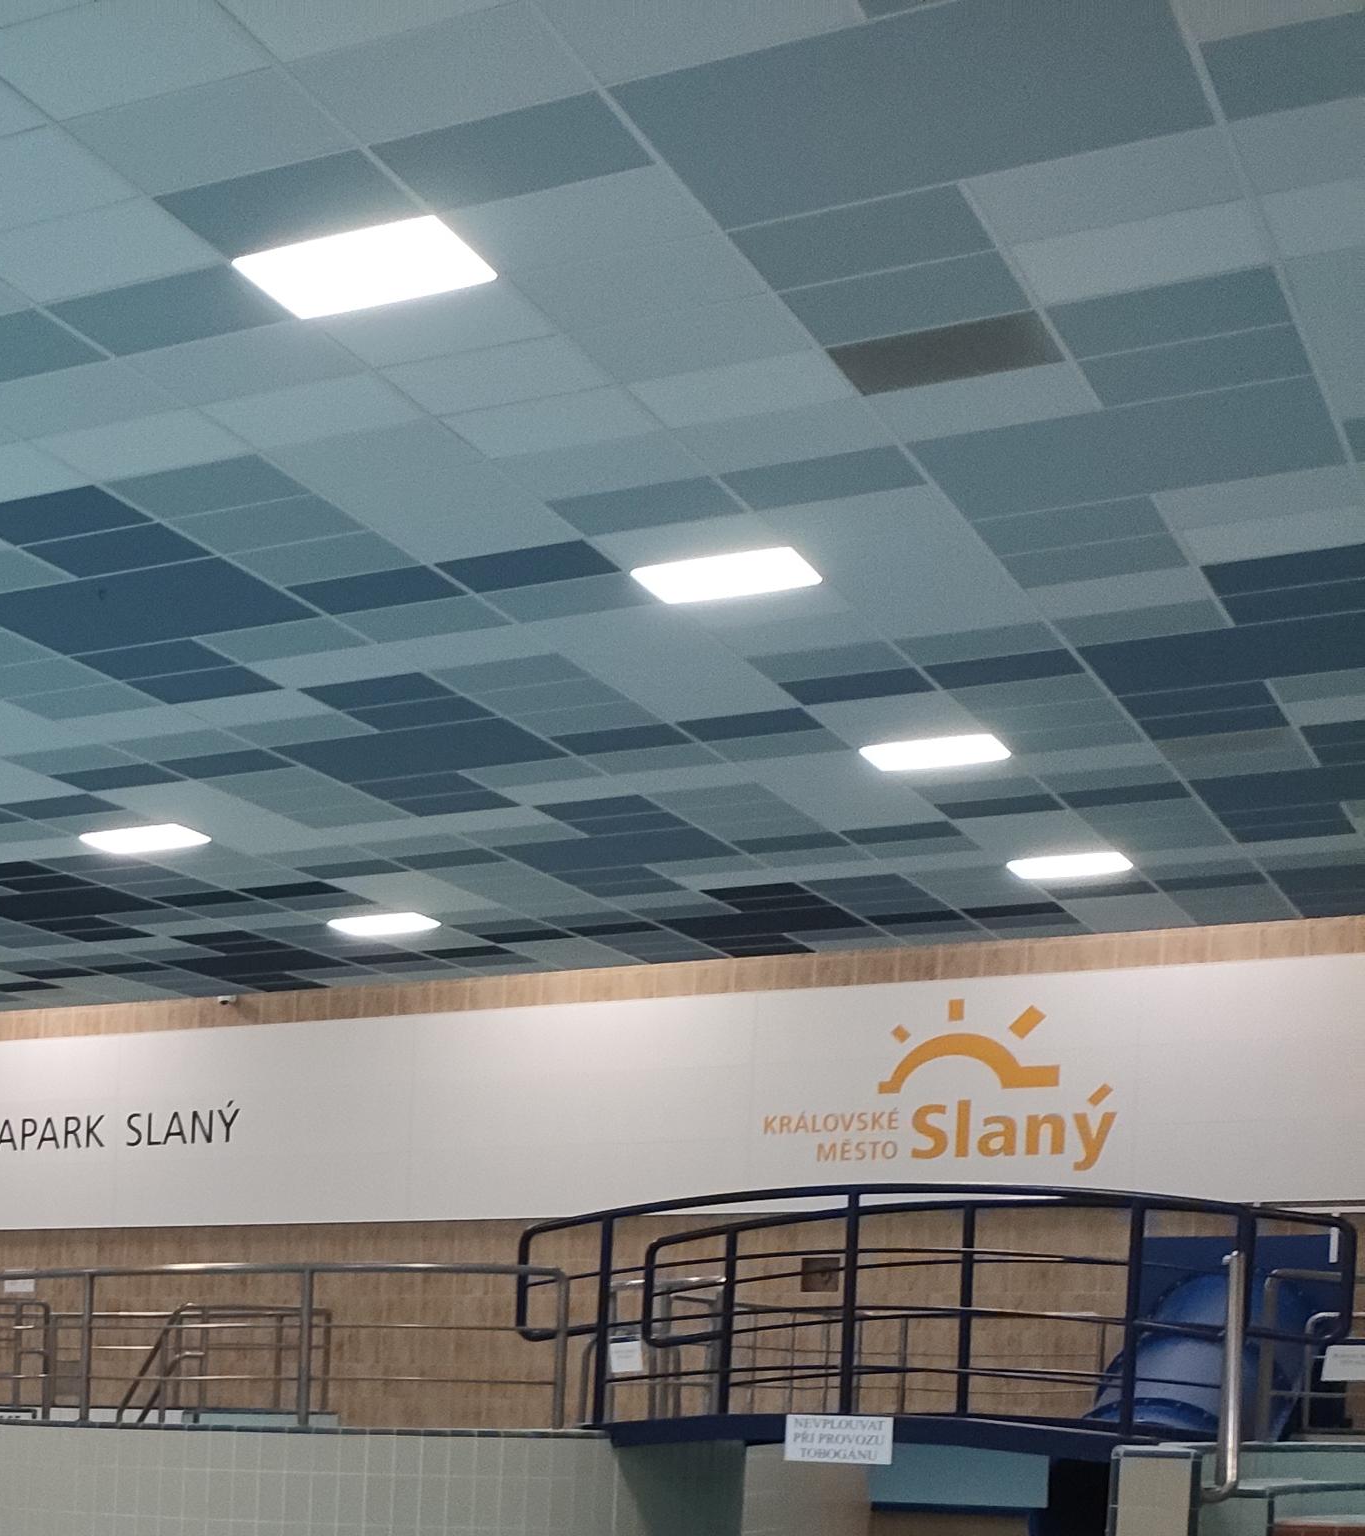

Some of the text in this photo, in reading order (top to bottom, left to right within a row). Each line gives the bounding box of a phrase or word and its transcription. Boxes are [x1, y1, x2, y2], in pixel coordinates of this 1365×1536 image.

[126, 1100, 241, 1147] SLANÝ
[763, 1107, 901, 1135] KRÁLOVSKÉ
[910, 1083, 1118, 1172] Slaný
[816, 1140, 899, 1163] MĚSTO
